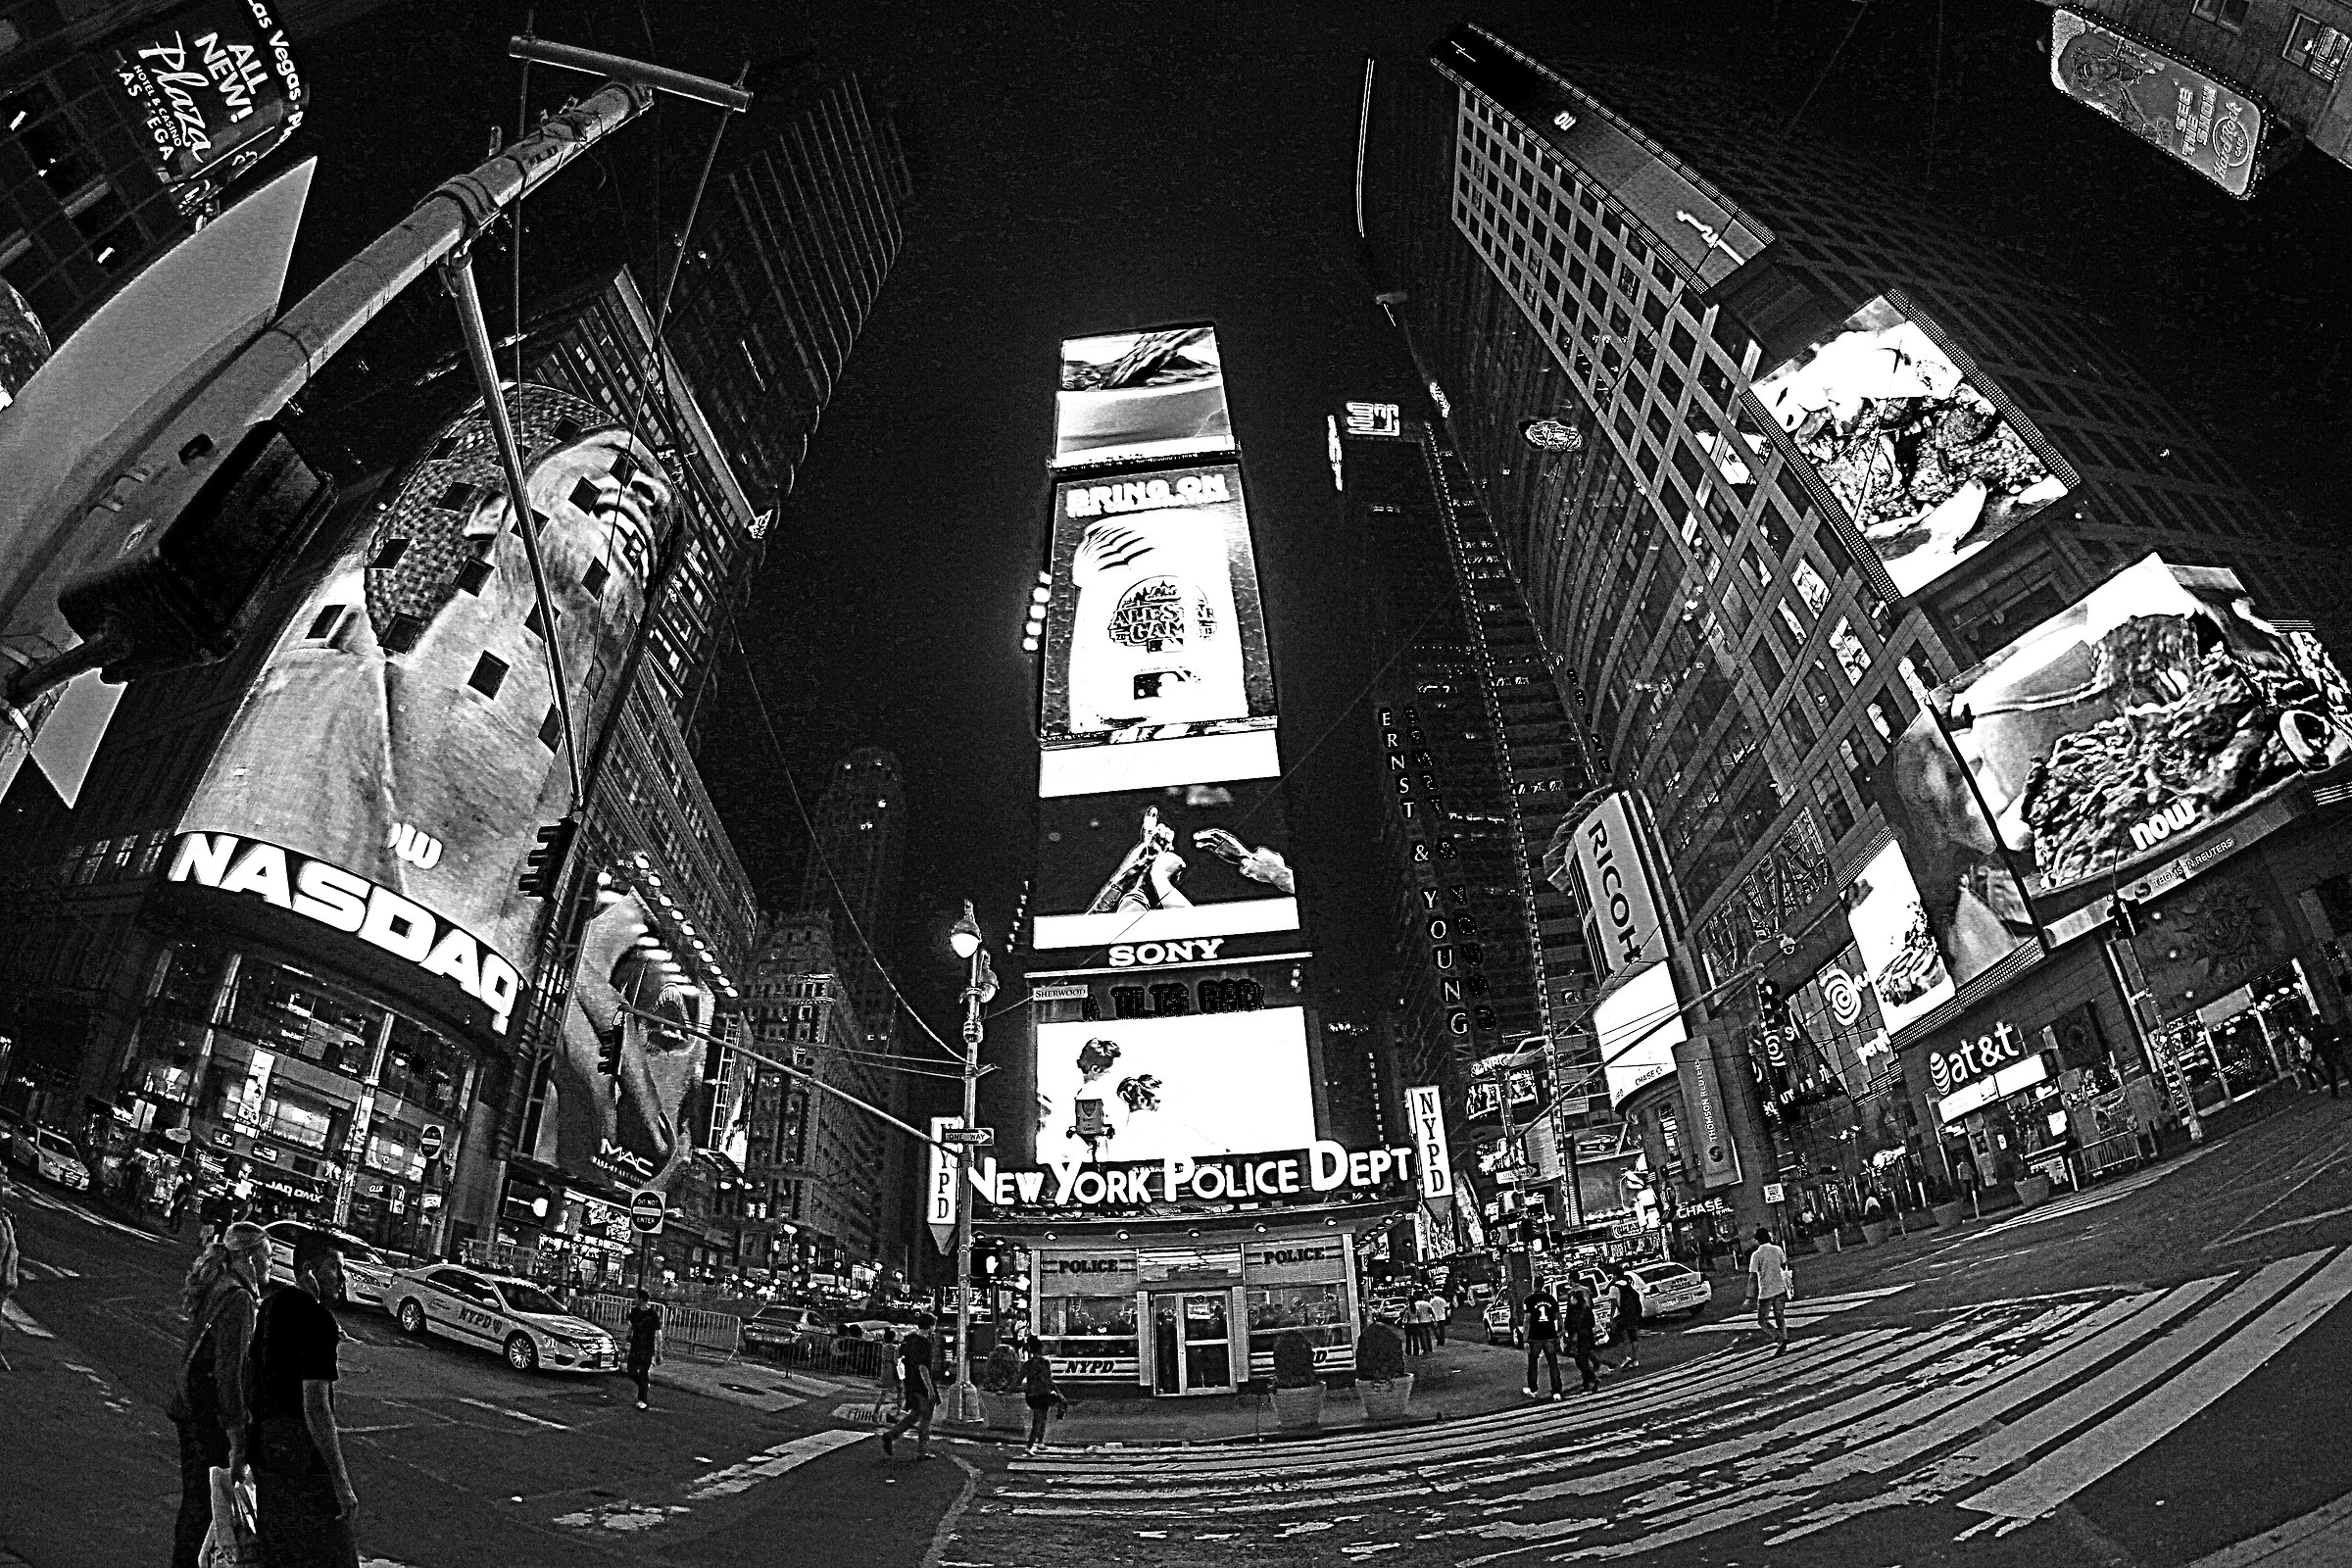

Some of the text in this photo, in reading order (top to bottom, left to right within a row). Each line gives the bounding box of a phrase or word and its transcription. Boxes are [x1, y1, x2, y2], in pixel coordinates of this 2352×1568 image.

[194, 32, 253, 123] NEW!
[226, 44, 268, 95] ALL
[269, 29, 302, 101] Vegas
[117, 69, 174, 161] AS EGA
[133, 65, 182, 147] HOTEL & CASINO
[138, 30, 212, 164] Plaza
[2176, 88, 2193, 130] SEE
[2196, 85, 2218, 146] SHOW
[2181, 116, 2198, 157] THE
[2212, 101, 2244, 180] Hard Rock
[2129, 799, 2197, 851] now
[1382, 712, 1415, 819] ERNST
[1414, 844, 1429, 861] &
[1424, 889, 1469, 1035] YOUNG
[2195, 837, 2235, 869] REUTERS
[1588, 819, 1642, 965] RICOH
[168, 833, 520, 1036] NASDAQ
[1108, 938, 1225, 967] SONY
[1035, 987, 1086, 1000] SHERWOOD
[1948, 1020, 2020, 1083] at&t
[1635, 1070, 1656, 1086] CHASE
[949, 1132, 986, 1141] ONE WAY
[1418, 1092, 1446, 1193] NYPD
[1702, 1098, 1717, 1142] THOMSON
[968, 1156, 1045, 1205] NEW
[1050, 1156, 1152, 1207] YORK
[1163, 1153, 1300, 1202] POLICE
[1677, 1197, 1726, 1220] CHASE
[1058, 1259, 1118, 1274] POLICE
[1263, 1247, 1327, 1265] POLICE
[458, 1305, 492, 1330] NYPD
[1538, 1305, 1549, 1322] 1
[1066, 1359, 1115, 1375] NYPD
